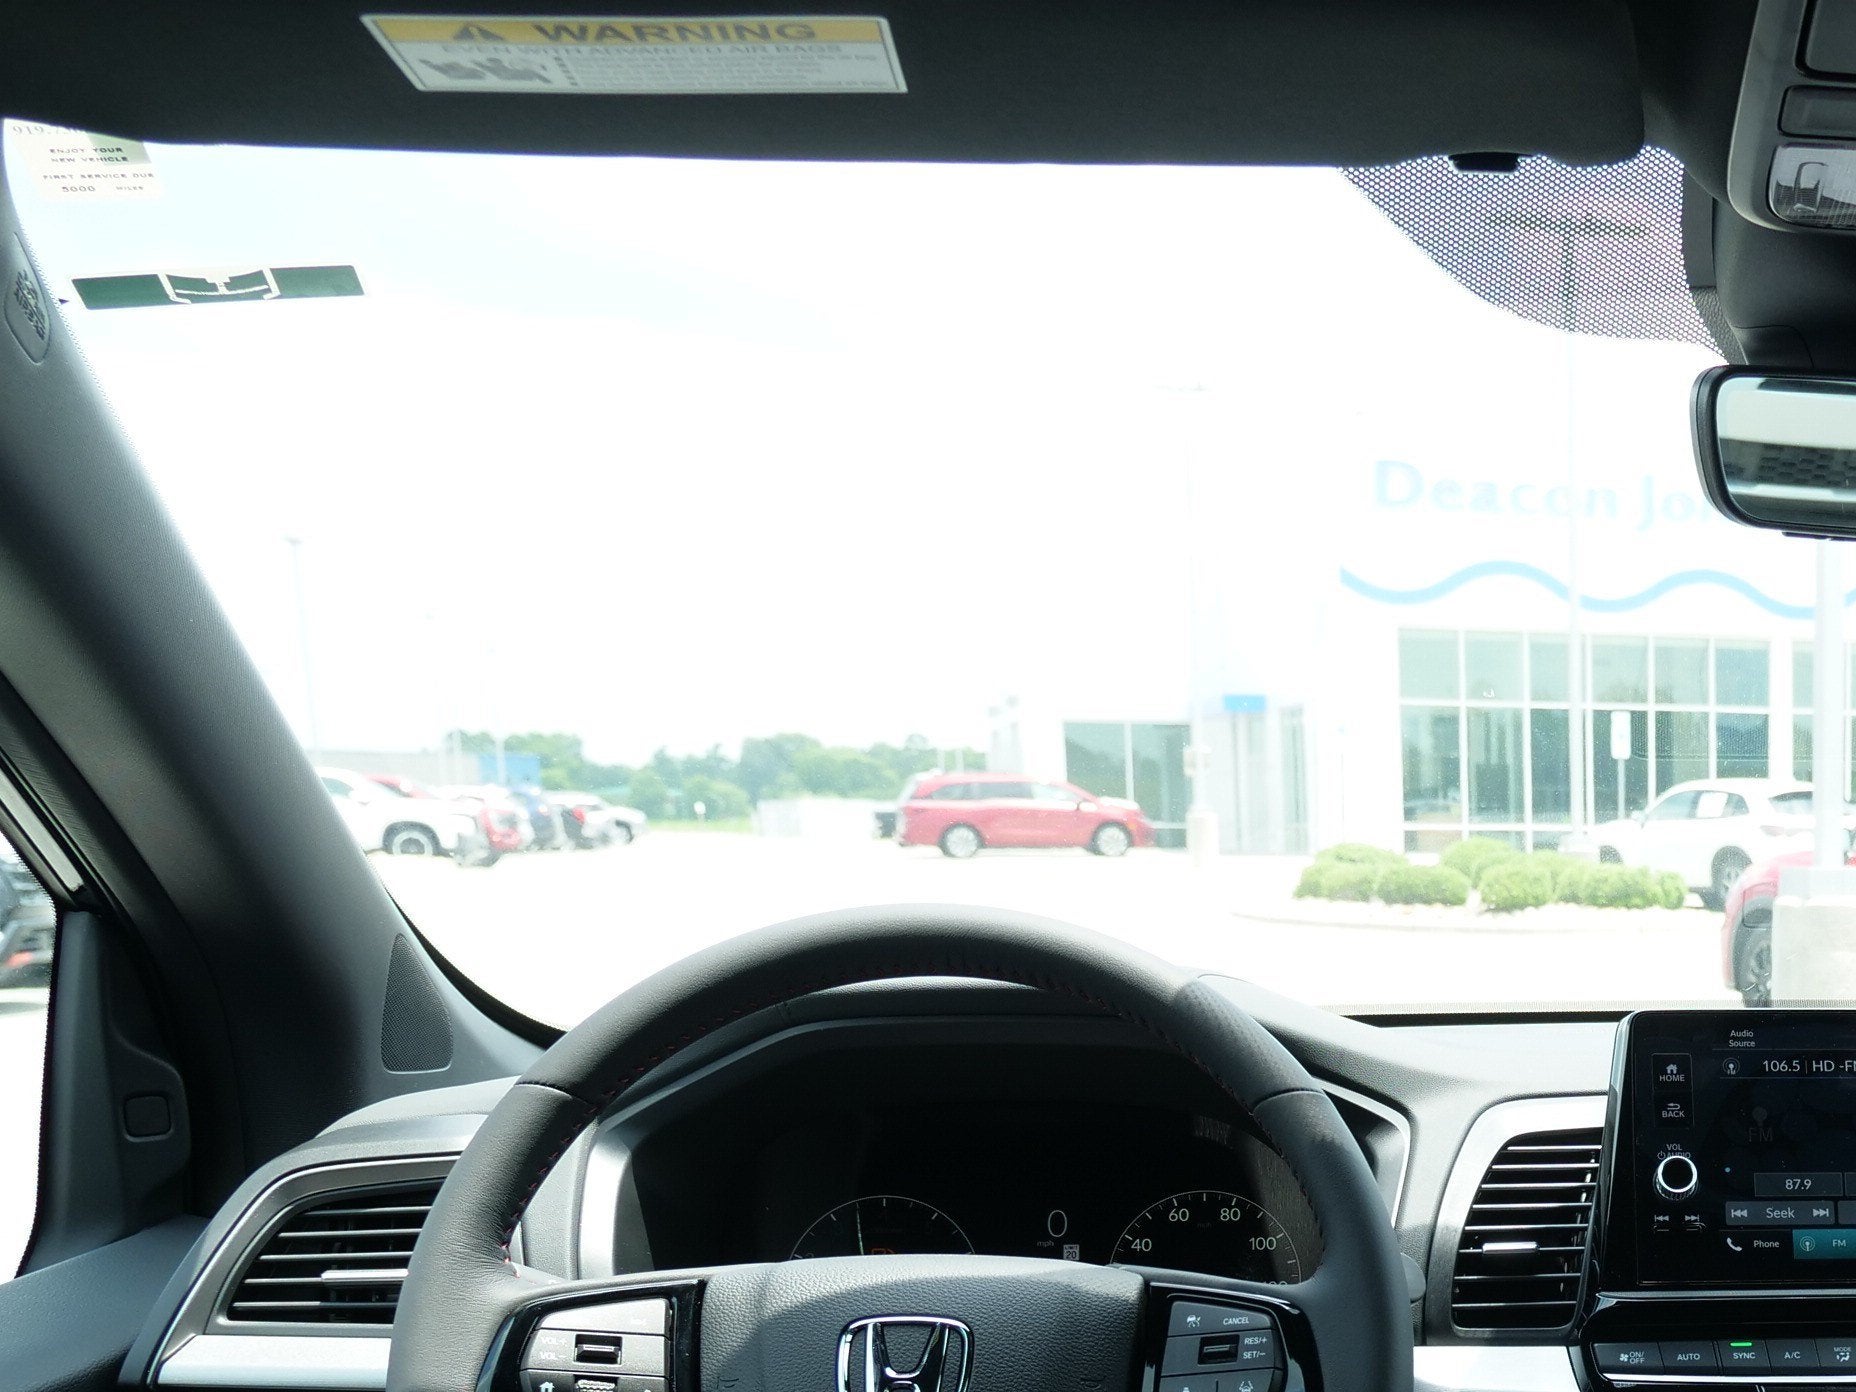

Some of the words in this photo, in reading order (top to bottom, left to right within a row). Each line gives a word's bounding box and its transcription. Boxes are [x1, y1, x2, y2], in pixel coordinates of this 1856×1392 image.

[532, 22, 817, 42] WARNING
[1374, 459, 1620, 519] Deacon
[1730, 1029, 1754, 1038] Audio
[1728, 1039, 1756, 1048] Source
[1762, 1060, 1800, 1072] 106.5
[1812, 1060, 1835, 1072] HD
[1659, 1074, 1685, 1082] HOME
[1661, 1110, 1685, 1118] BACK
[1666, 1143, 1683, 1151] VOL
[1785, 1179, 1812, 1190] 87.9
[1168, 1208, 1190, 1222] 60
[1219, 1208, 1241, 1222] 80
[1766, 1207, 1795, 1219] Seek
[1130, 1238, 1153, 1252] 40
[1249, 1237, 1277, 1251] 100
[1753, 1240, 1780, 1248] Phone
[1832, 1239, 1847, 1247] FM
[1222, 1316, 1250, 1326] CANCEL
[1676, 1352, 1701, 1361] AUTO
[1732, 1352, 1756, 1360] SYNC
[1783, 1351, 1801, 1360] A/C
